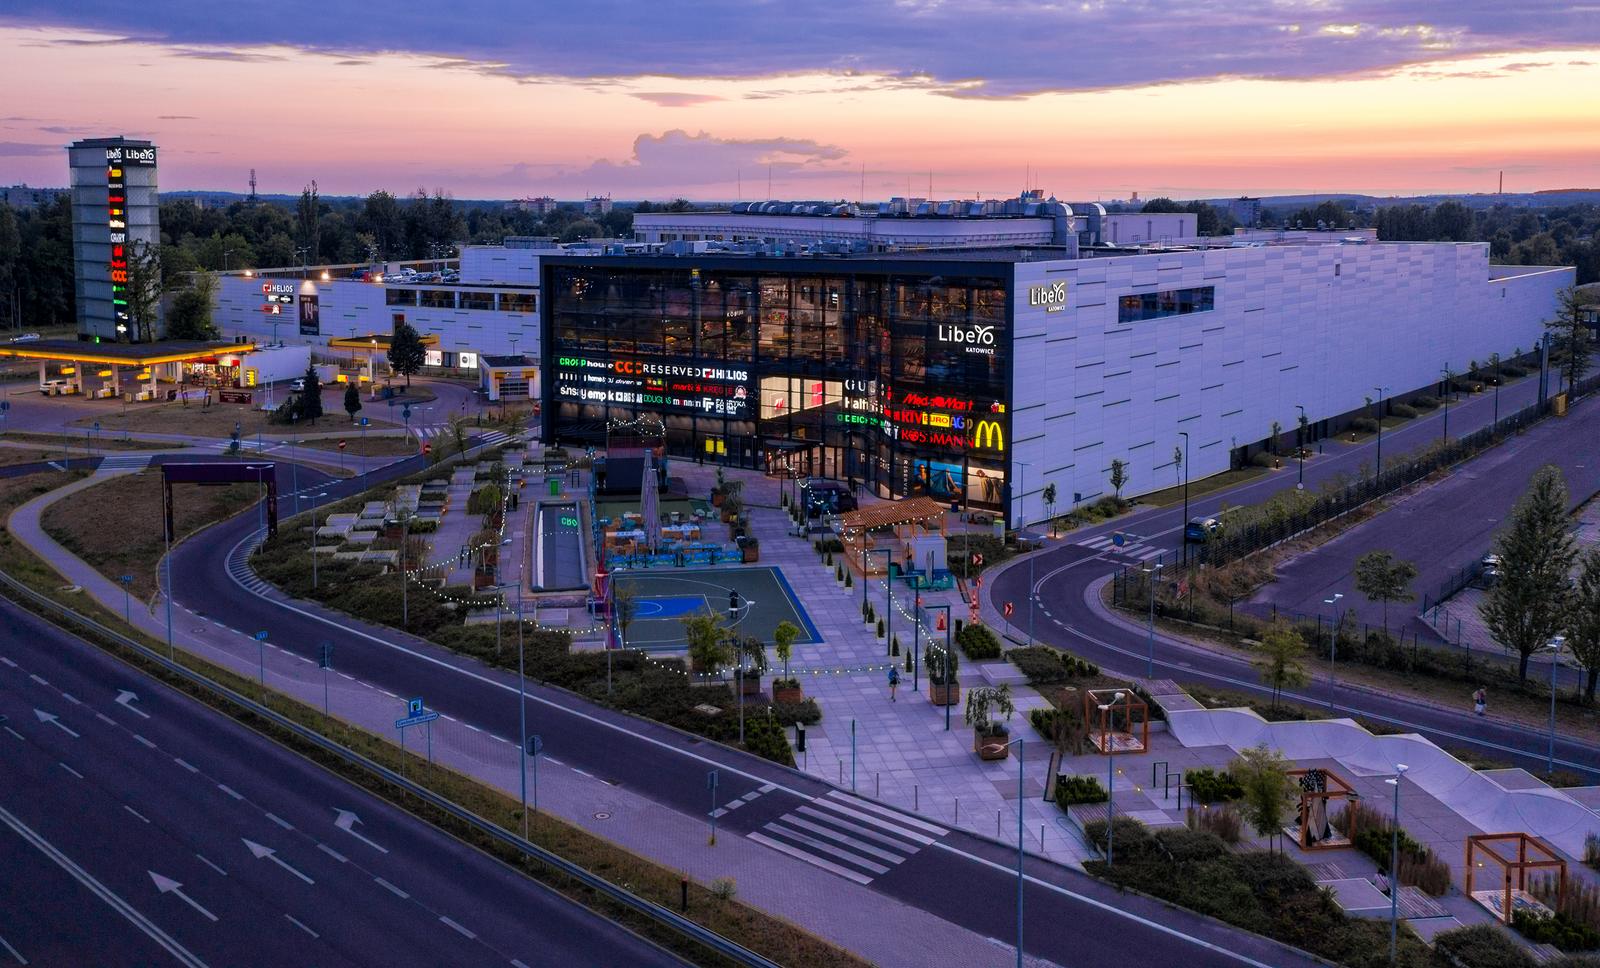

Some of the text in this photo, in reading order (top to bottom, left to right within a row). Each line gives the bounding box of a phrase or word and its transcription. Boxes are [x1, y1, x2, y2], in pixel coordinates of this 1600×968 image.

[112, 269, 127, 282] CCC
[272, 284, 293, 293] HELIOS
[966, 346, 994, 355] KATOWICE
[615, 360, 642, 374] CCC
[587, 390, 614, 401] empk
